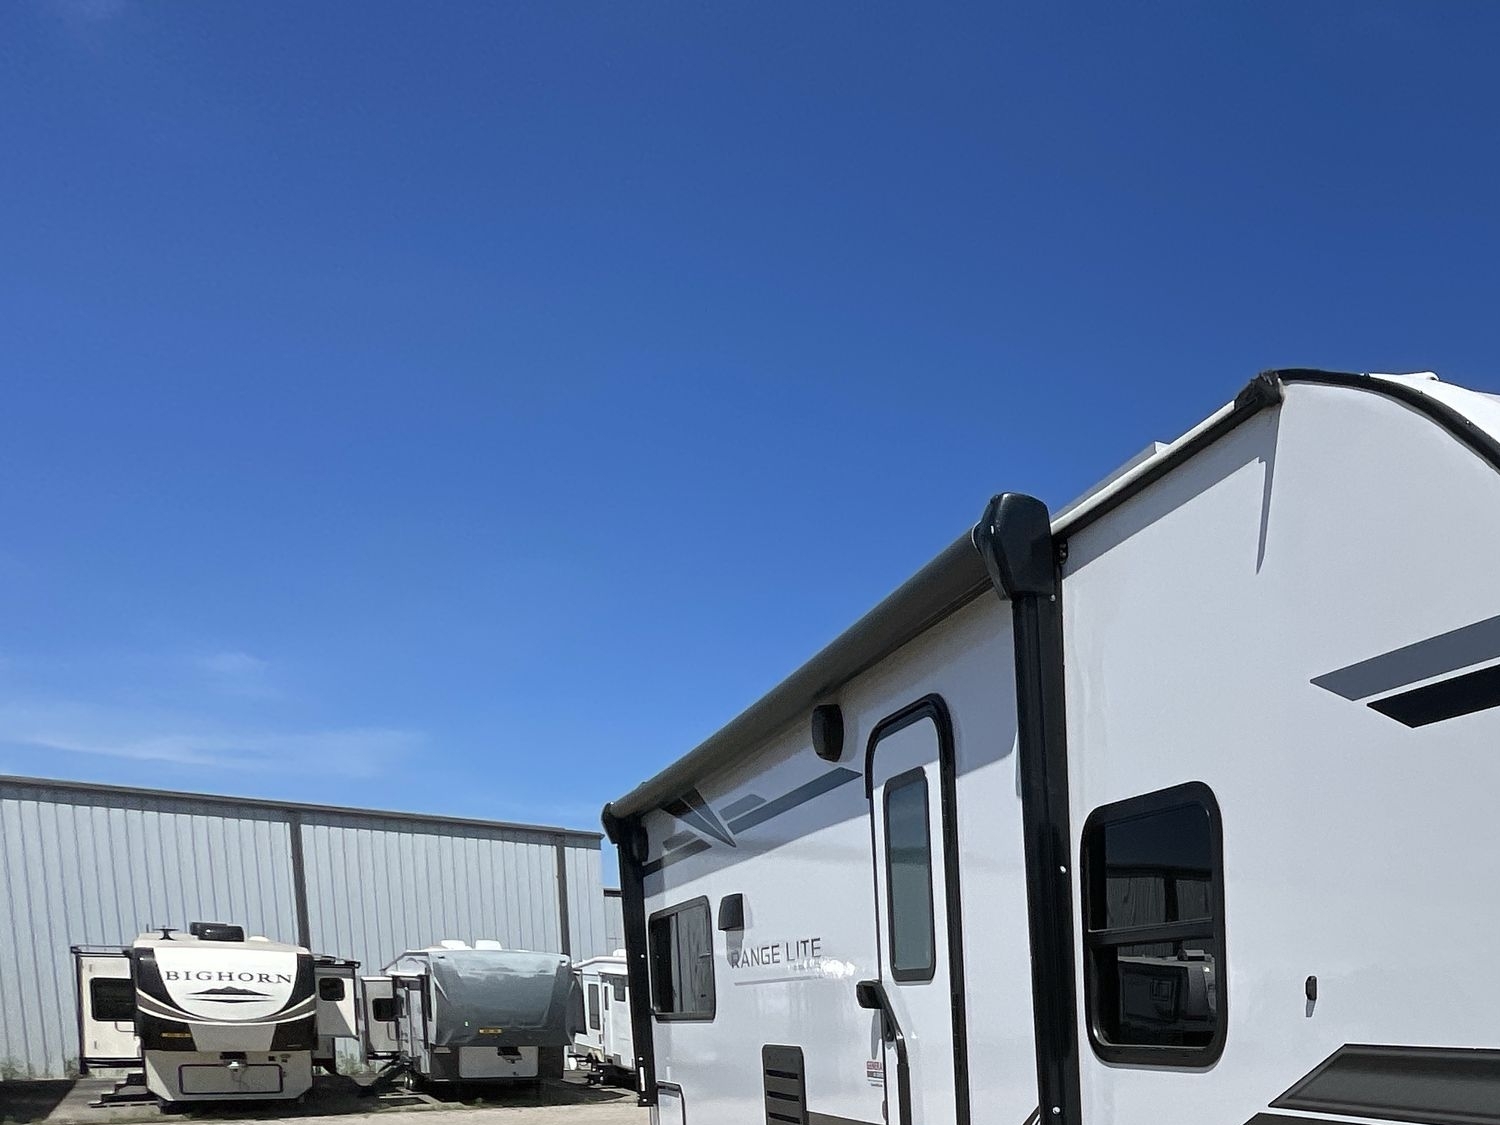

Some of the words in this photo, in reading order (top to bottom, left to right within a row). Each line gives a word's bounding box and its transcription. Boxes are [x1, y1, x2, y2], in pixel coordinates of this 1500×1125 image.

[731, 944, 781, 969] RANGE
[786, 937, 821, 962] LITE
[165, 970, 293, 984] BIGHORN
